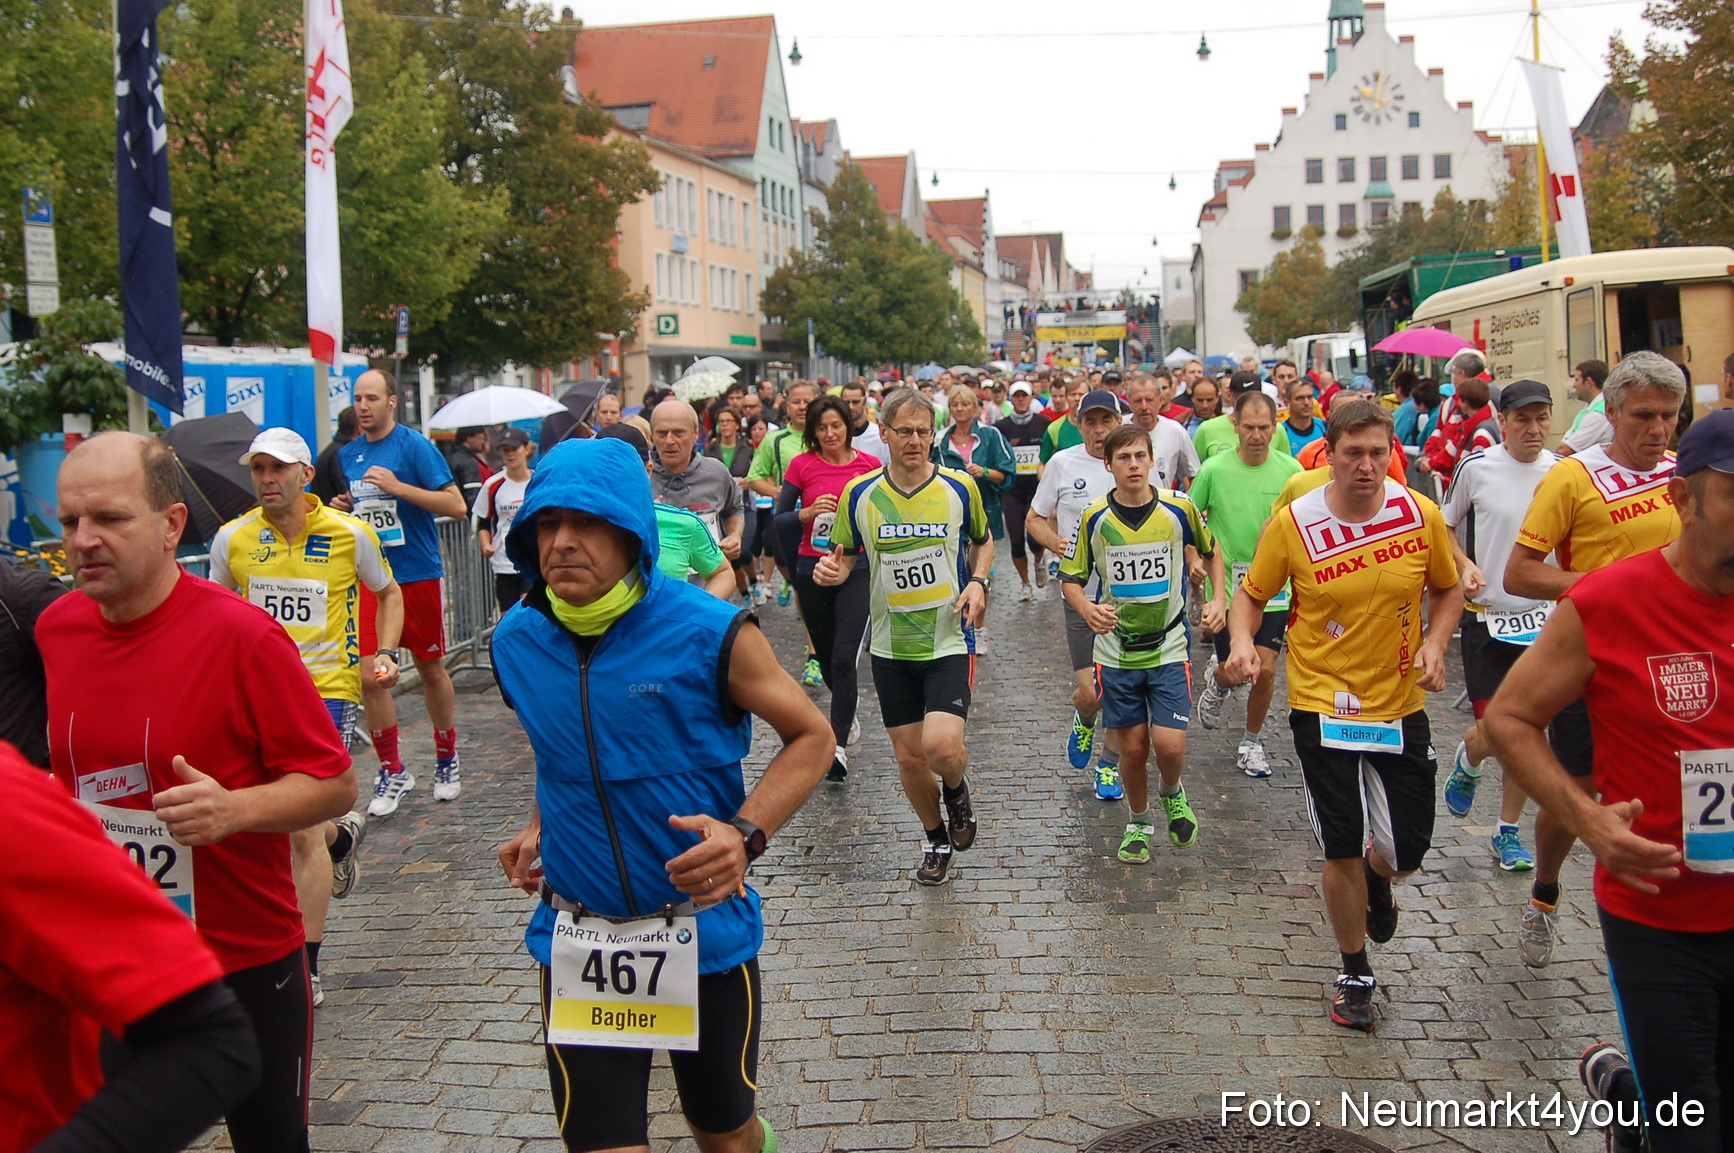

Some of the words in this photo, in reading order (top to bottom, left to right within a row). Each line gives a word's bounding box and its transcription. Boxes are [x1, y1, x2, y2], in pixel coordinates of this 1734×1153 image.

[659, 316, 676, 333] D
[1490, 310, 1540, 336] Bayerisches
[1490, 338, 1513, 356] Rotes
[227, 383, 264, 405] DIXI
[1016, 453, 1034, 463] 237
[1609, 498, 1660, 525] MAX
[879, 523, 948, 538] BOCK
[304, 534, 333, 557] E
[1128, 549, 1160, 557] Neumarkt
[901, 553, 933, 565] Neumarkt
[1314, 554, 1369, 585] MAX
[1373, 536, 1429, 565] BÖGL
[893, 562, 936, 590] 560
[1112, 556, 1166, 582] 3125
[251, 583, 275, 592] PARTL
[277, 585, 313, 593] Neumarkt
[264, 595, 311, 622] 565
[1494, 611, 1547, 635] 2903
[1659, 661, 1706, 676] IMMER
[1659, 671, 1710, 686] WIEDER
[629, 683, 663, 693] GORE
[1664, 683, 1707, 701] NEU
[1666, 699, 1708, 712] MARKT
[1341, 728, 1382, 741] Richard
[1684, 762, 1734, 774] PARTL
[96, 775, 127, 793] DEHN
[1698, 781, 1734, 826] 2
[100, 818, 163, 837] Neumarkt
[556, 924, 602, 943] PARTL
[606, 931, 670, 944] Neumarkt
[580, 948, 667, 997] 467
[591, 1006, 657, 1031] Bagher
